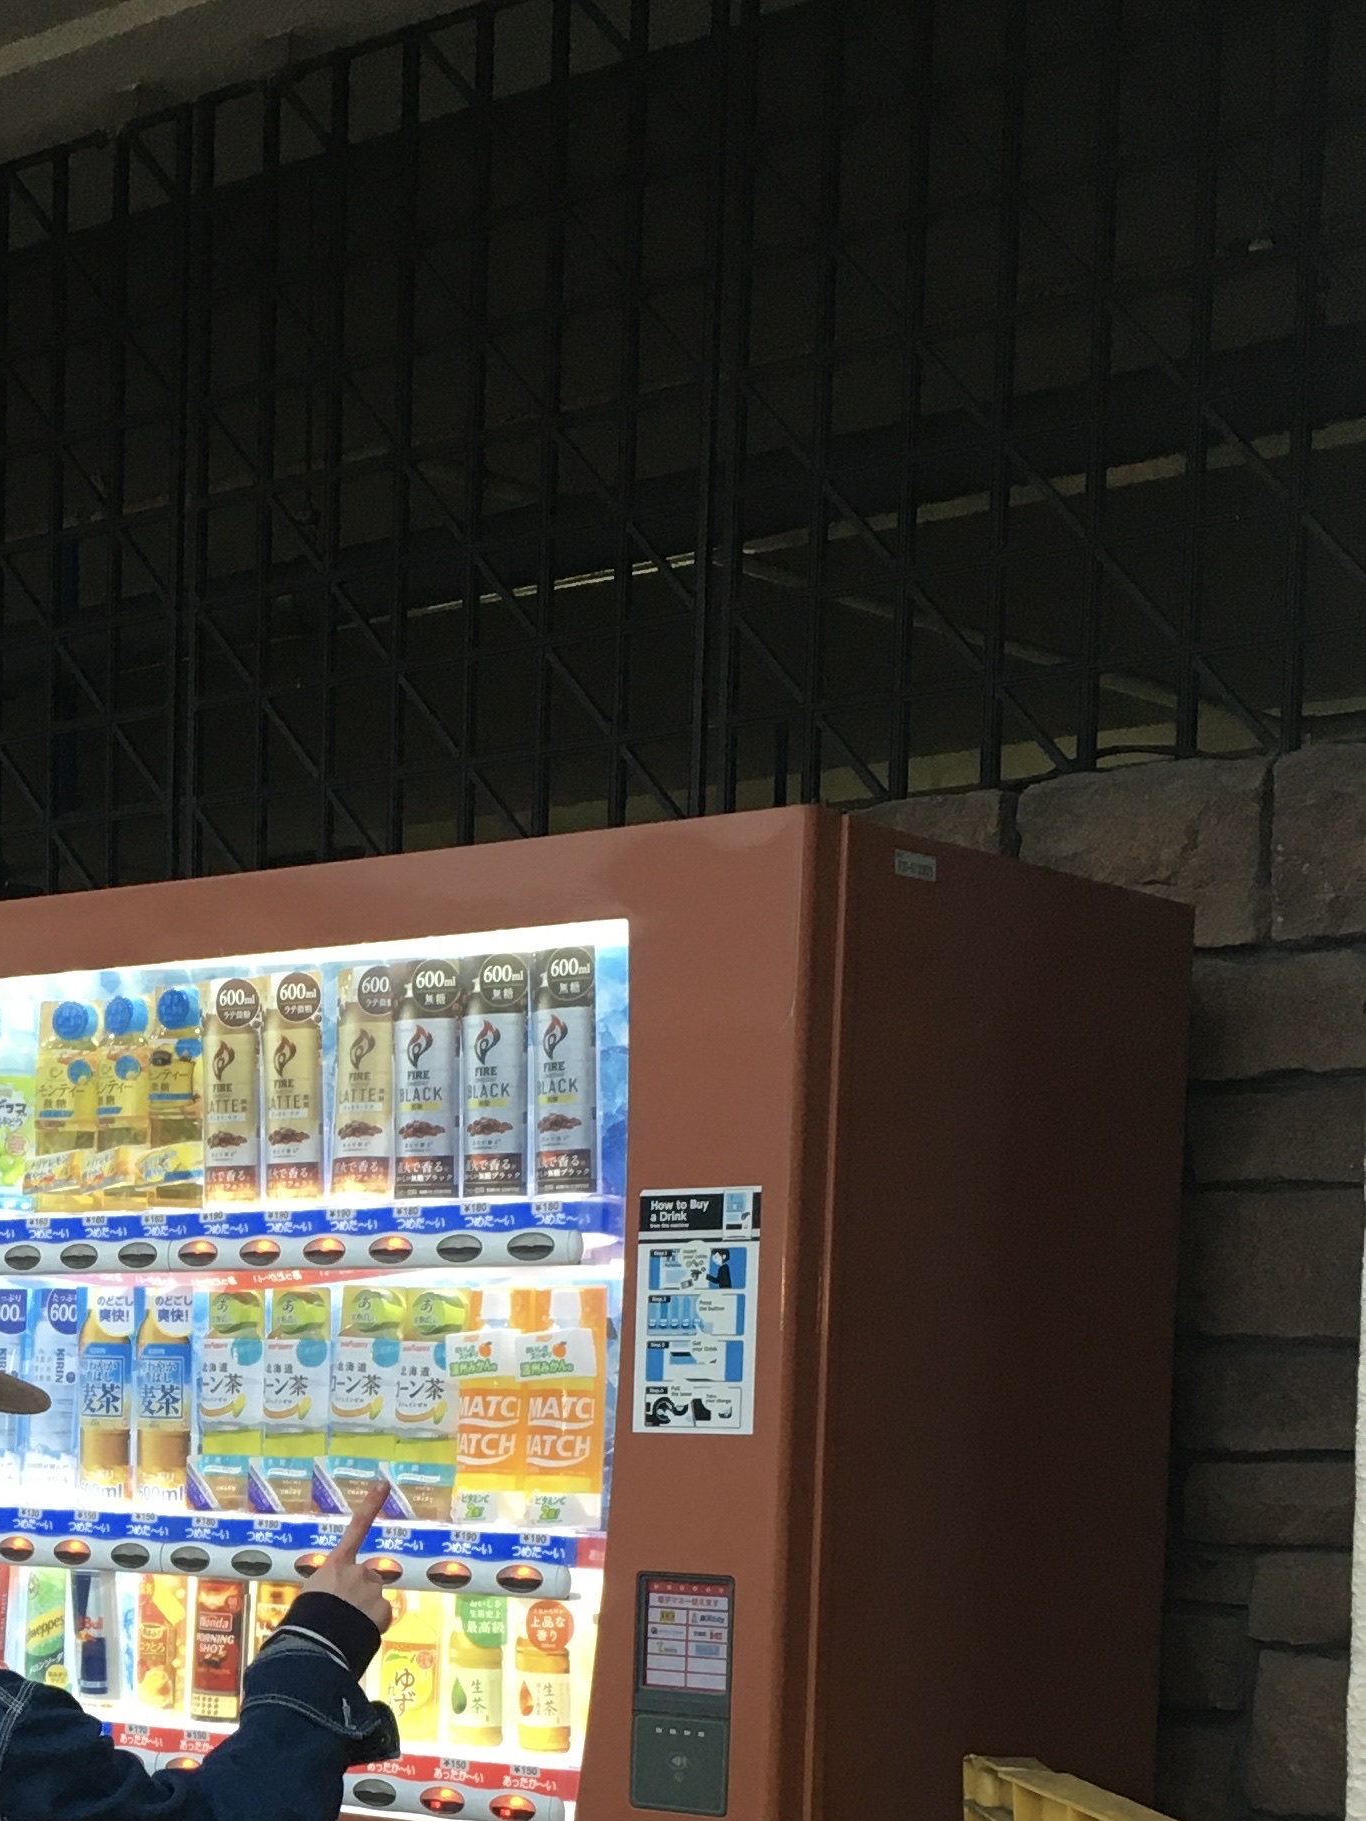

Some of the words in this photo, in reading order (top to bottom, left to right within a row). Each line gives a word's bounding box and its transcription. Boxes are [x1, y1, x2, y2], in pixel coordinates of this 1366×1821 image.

[484, 964, 524, 984] 600ml
[550, 957, 590, 976] 600ml
[416, 970, 456, 989] 600ml
[219, 989, 255, 1007] 600ml
[279, 983, 317, 1000] 600ml
[650, 1200, 674, 1211] How
[676, 1200, 688, 1210] to
[690, 1199, 710, 1212] Buy
[650, 1214, 657, 1222] a
[659, 1211, 687, 1221] Drink
[530, 1615, 566, 1628] 上品な
